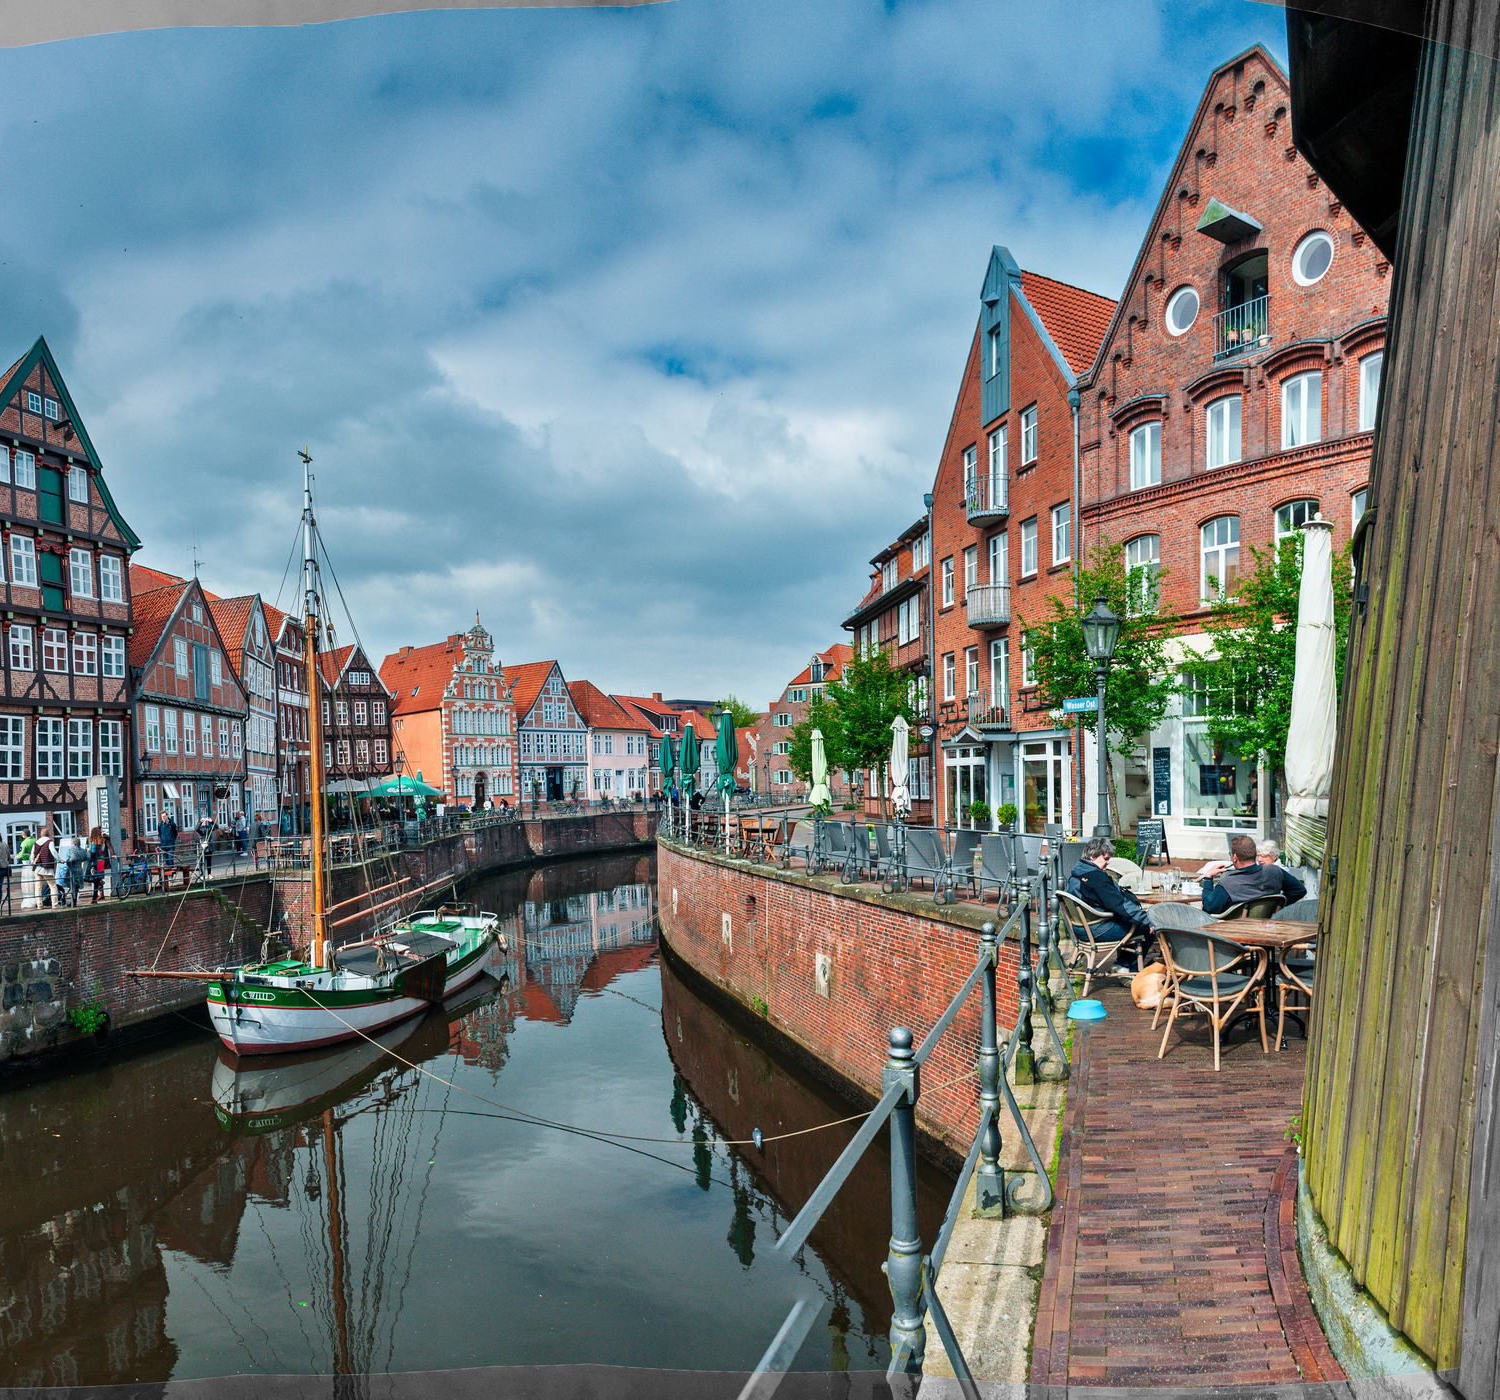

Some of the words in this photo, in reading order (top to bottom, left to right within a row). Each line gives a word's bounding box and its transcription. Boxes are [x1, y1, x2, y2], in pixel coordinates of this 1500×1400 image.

[1066, 701, 1085, 710] Wasser
[1085, 699, 1096, 708] Ost
[100, 789, 110, 837] NSTHAUS
